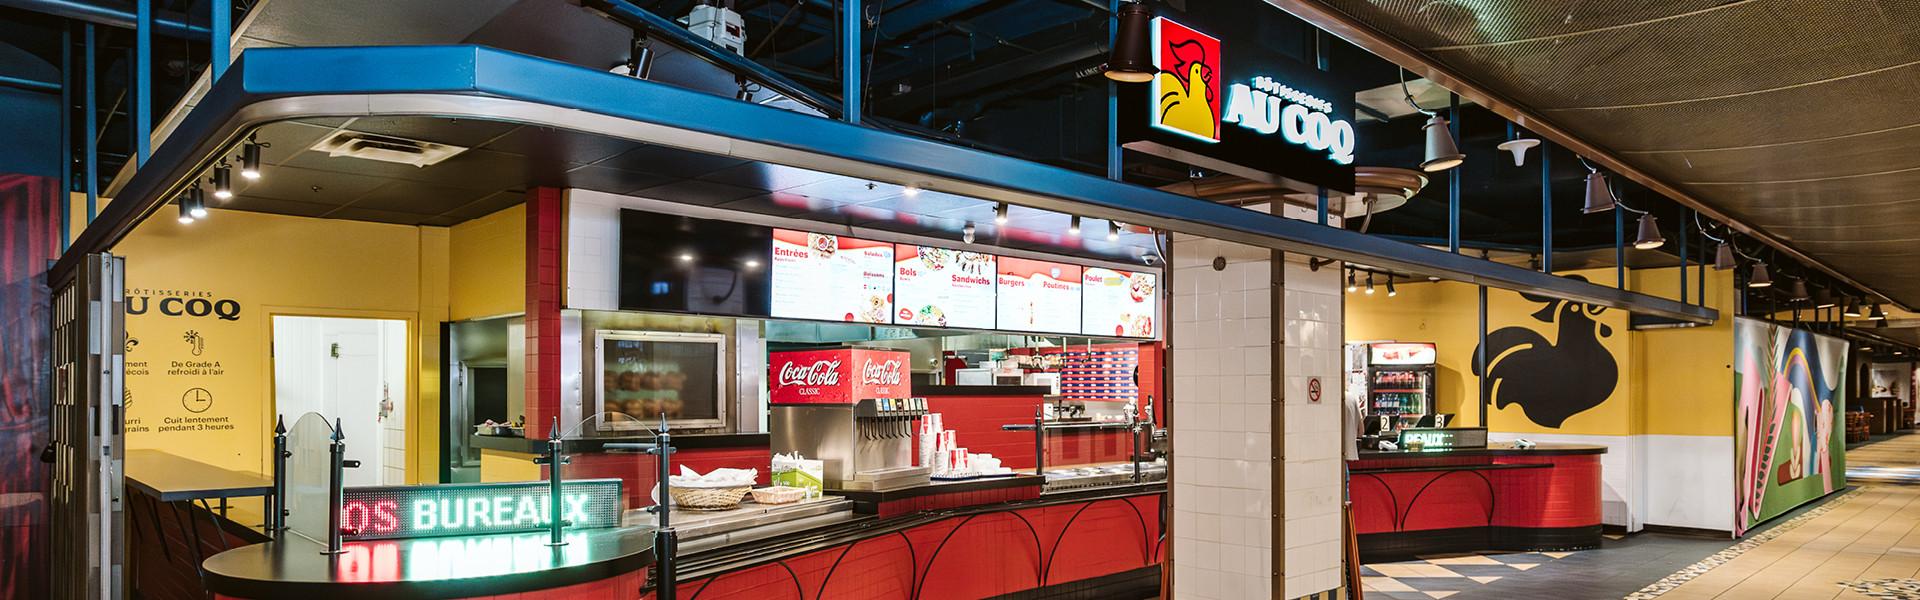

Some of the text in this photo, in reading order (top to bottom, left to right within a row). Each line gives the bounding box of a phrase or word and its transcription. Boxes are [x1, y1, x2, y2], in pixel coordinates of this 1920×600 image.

[1222, 83, 1355, 165] AU COQ
[775, 247, 809, 259] Entrées
[900, 267, 917, 277] Bols
[952, 274, 990, 286] Sandwichs
[998, 277, 1025, 288] Burgers
[1085, 274, 1103, 283] Poulet
[1043, 281, 1070, 291] Poutines
[125, 287, 212, 297] RÔTISSERIES
[159, 297, 241, 321] COQ
[167, 368, 200, 376] refroidi
[202, 368, 207, 376] à
[163, 416, 229, 425] Cuit lentement
[1381, 416, 1389, 430] 2
[1436, 415, 1444, 429] 3
[158, 423, 235, 433] pendant 3 heures
